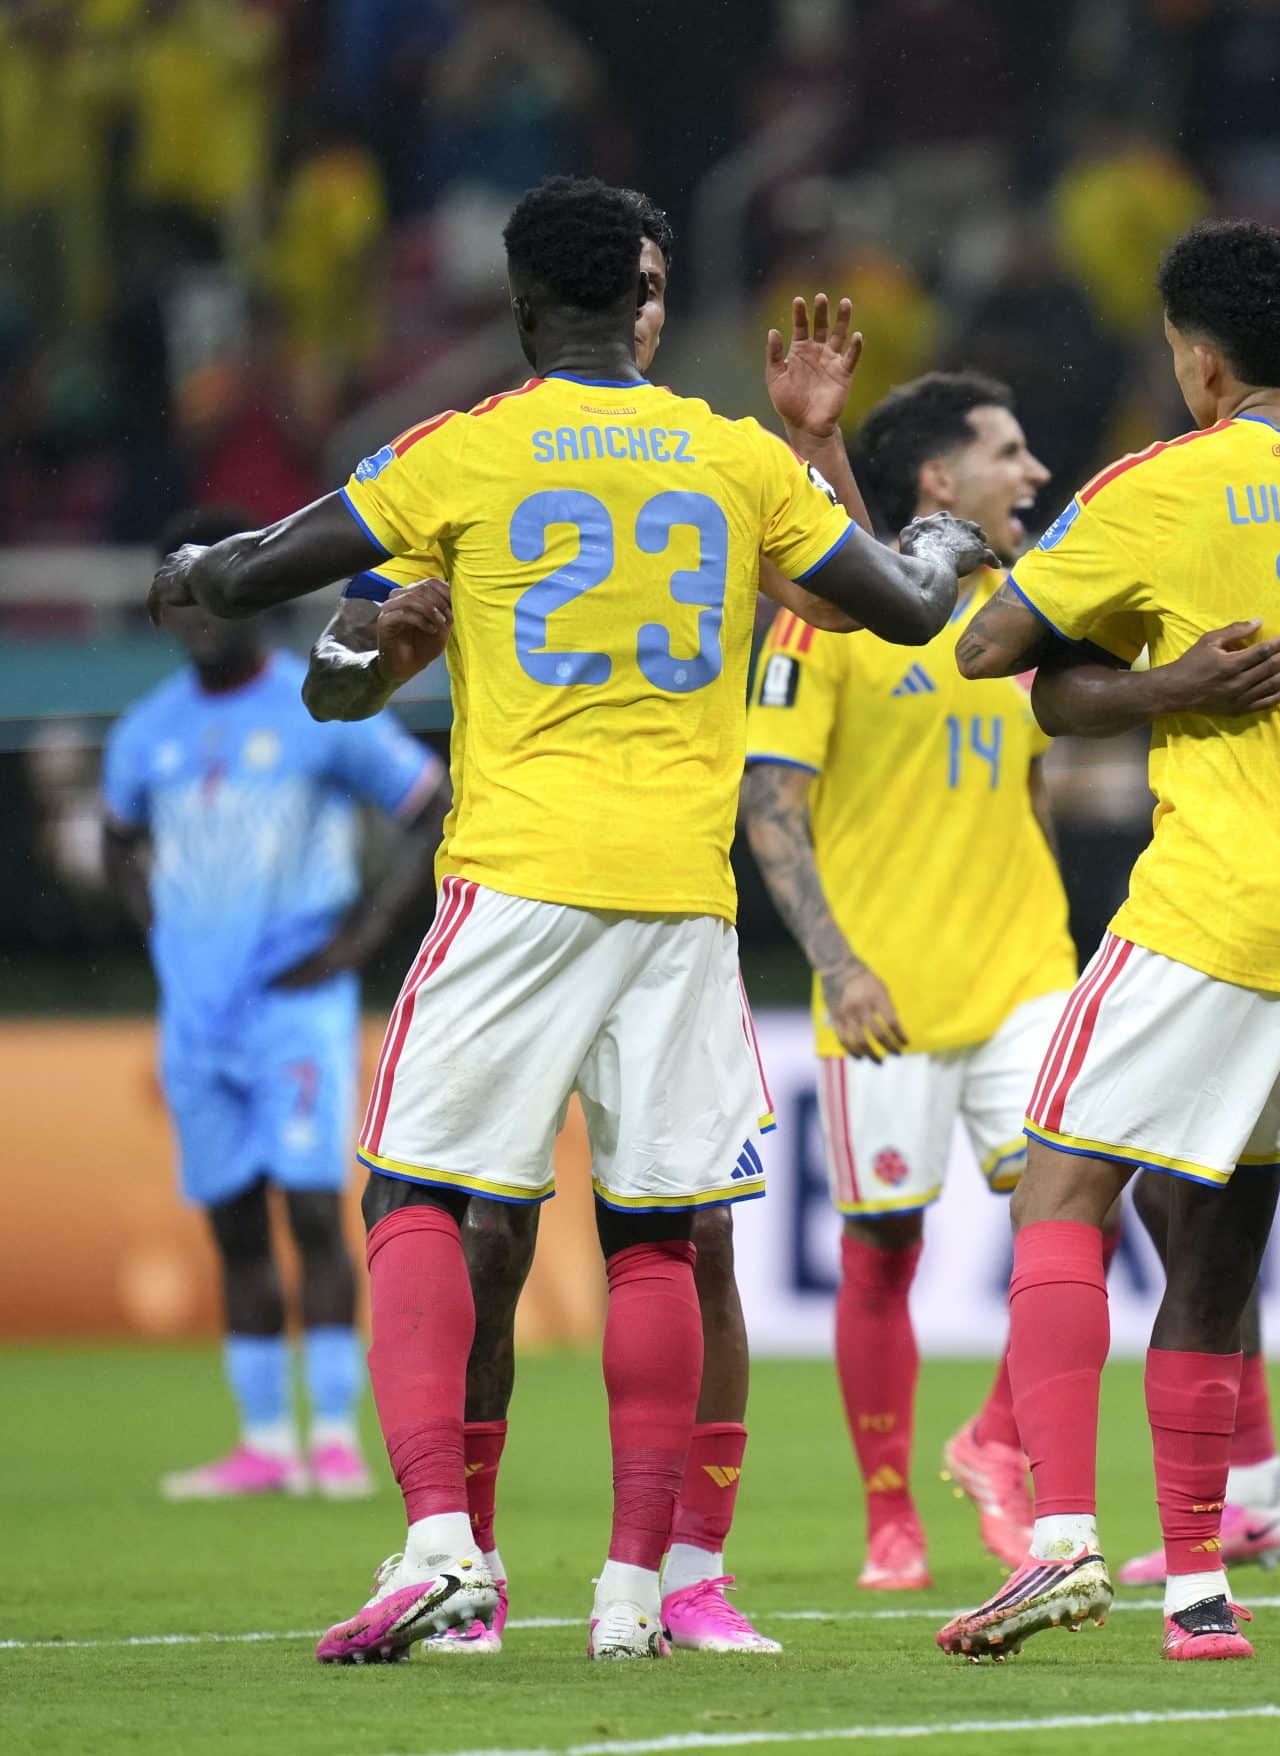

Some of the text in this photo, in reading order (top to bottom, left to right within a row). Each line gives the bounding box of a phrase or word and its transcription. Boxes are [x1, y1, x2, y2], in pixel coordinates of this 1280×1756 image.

[533, 426, 695, 462] SANCHEZ
[509, 489, 728, 692] 23
[947, 714, 1003, 789] 14
